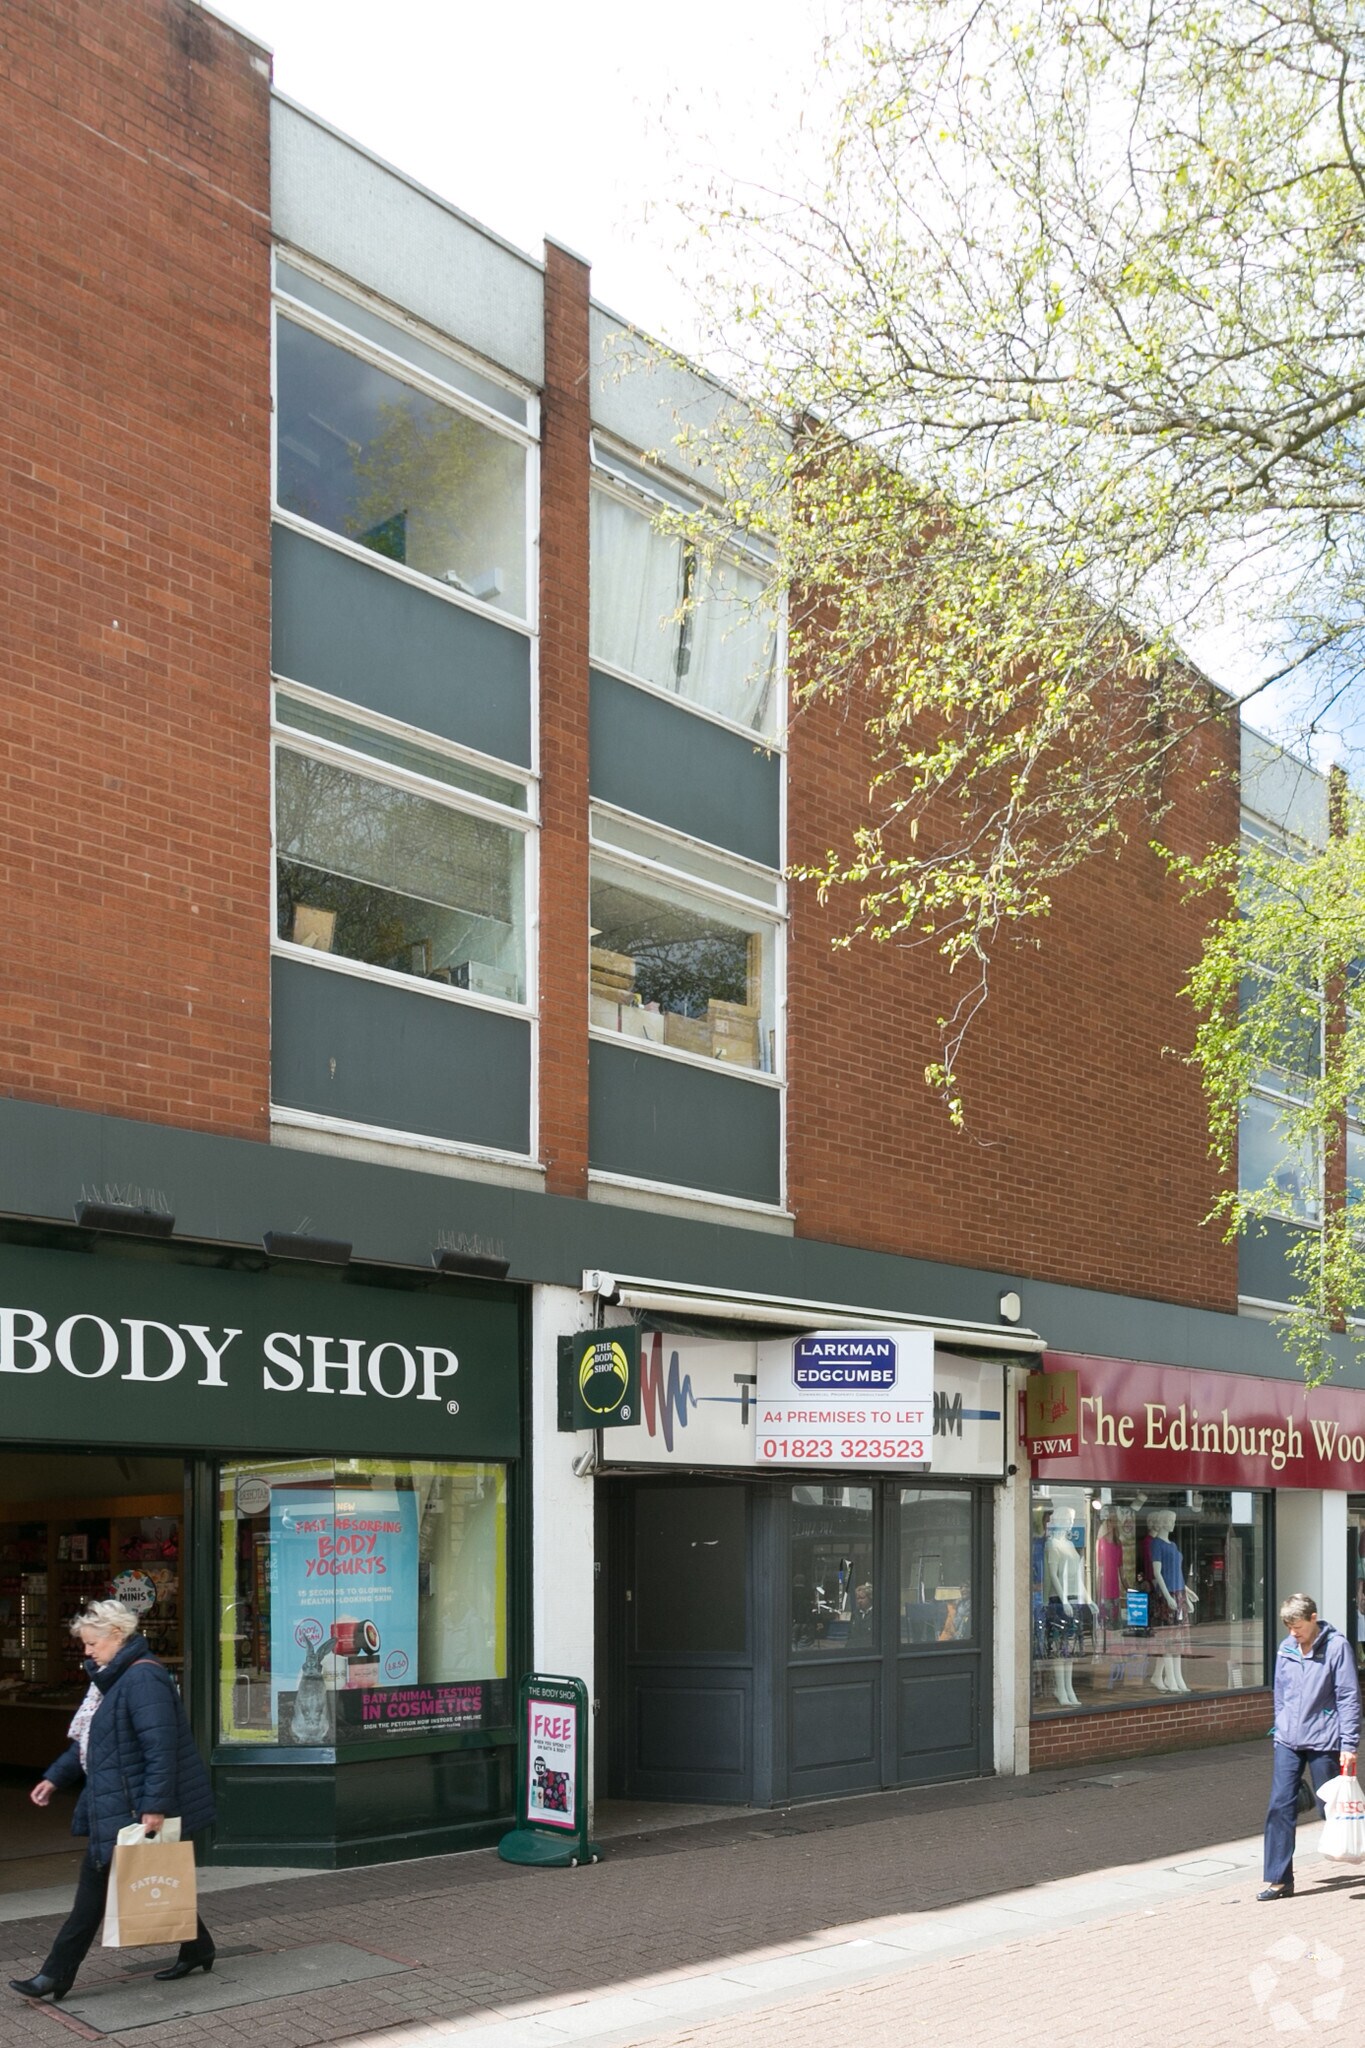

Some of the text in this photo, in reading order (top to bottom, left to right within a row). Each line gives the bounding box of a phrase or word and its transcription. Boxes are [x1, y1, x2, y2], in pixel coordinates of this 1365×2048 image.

[0, 1306, 243, 1387] BODY
[263, 1331, 459, 1401] SHOP
[596, 1342, 612, 1352] THE
[800, 1344, 890, 1356] LARKMAN
[594, 1352, 614, 1362] BODY
[594, 1363, 614, 1374] SHOP
[797, 1370, 894, 1382] EDGCUMBE
[764, 1411, 924, 1423] A4 PREMISES TO LET
[1144, 1402, 1304, 1471] Edinburgh
[1310, 1419, 1365, 1463] Woo
[764, 1439, 924, 1458] 01823 323523
[1032, 1438, 1072, 1454] EWM
[336, 1502, 356, 1512] NEW
[295, 1518, 402, 1534] FAST-ABSORBING
[318, 1533, 377, 1558] BODY
[306, 1556, 386, 1577] YOGURTS
[120, 1592, 146, 1602] MINIS
[362, 1686, 482, 1704] BAN ANIMAL TESTING
[528, 1686, 540, 1696] THE
[542, 1688, 558, 1698] BODY
[362, 1697, 482, 1720] IN COSMETICS
[534, 1714, 571, 1740] FREE
[129, 1876, 180, 1892] FATFACE
